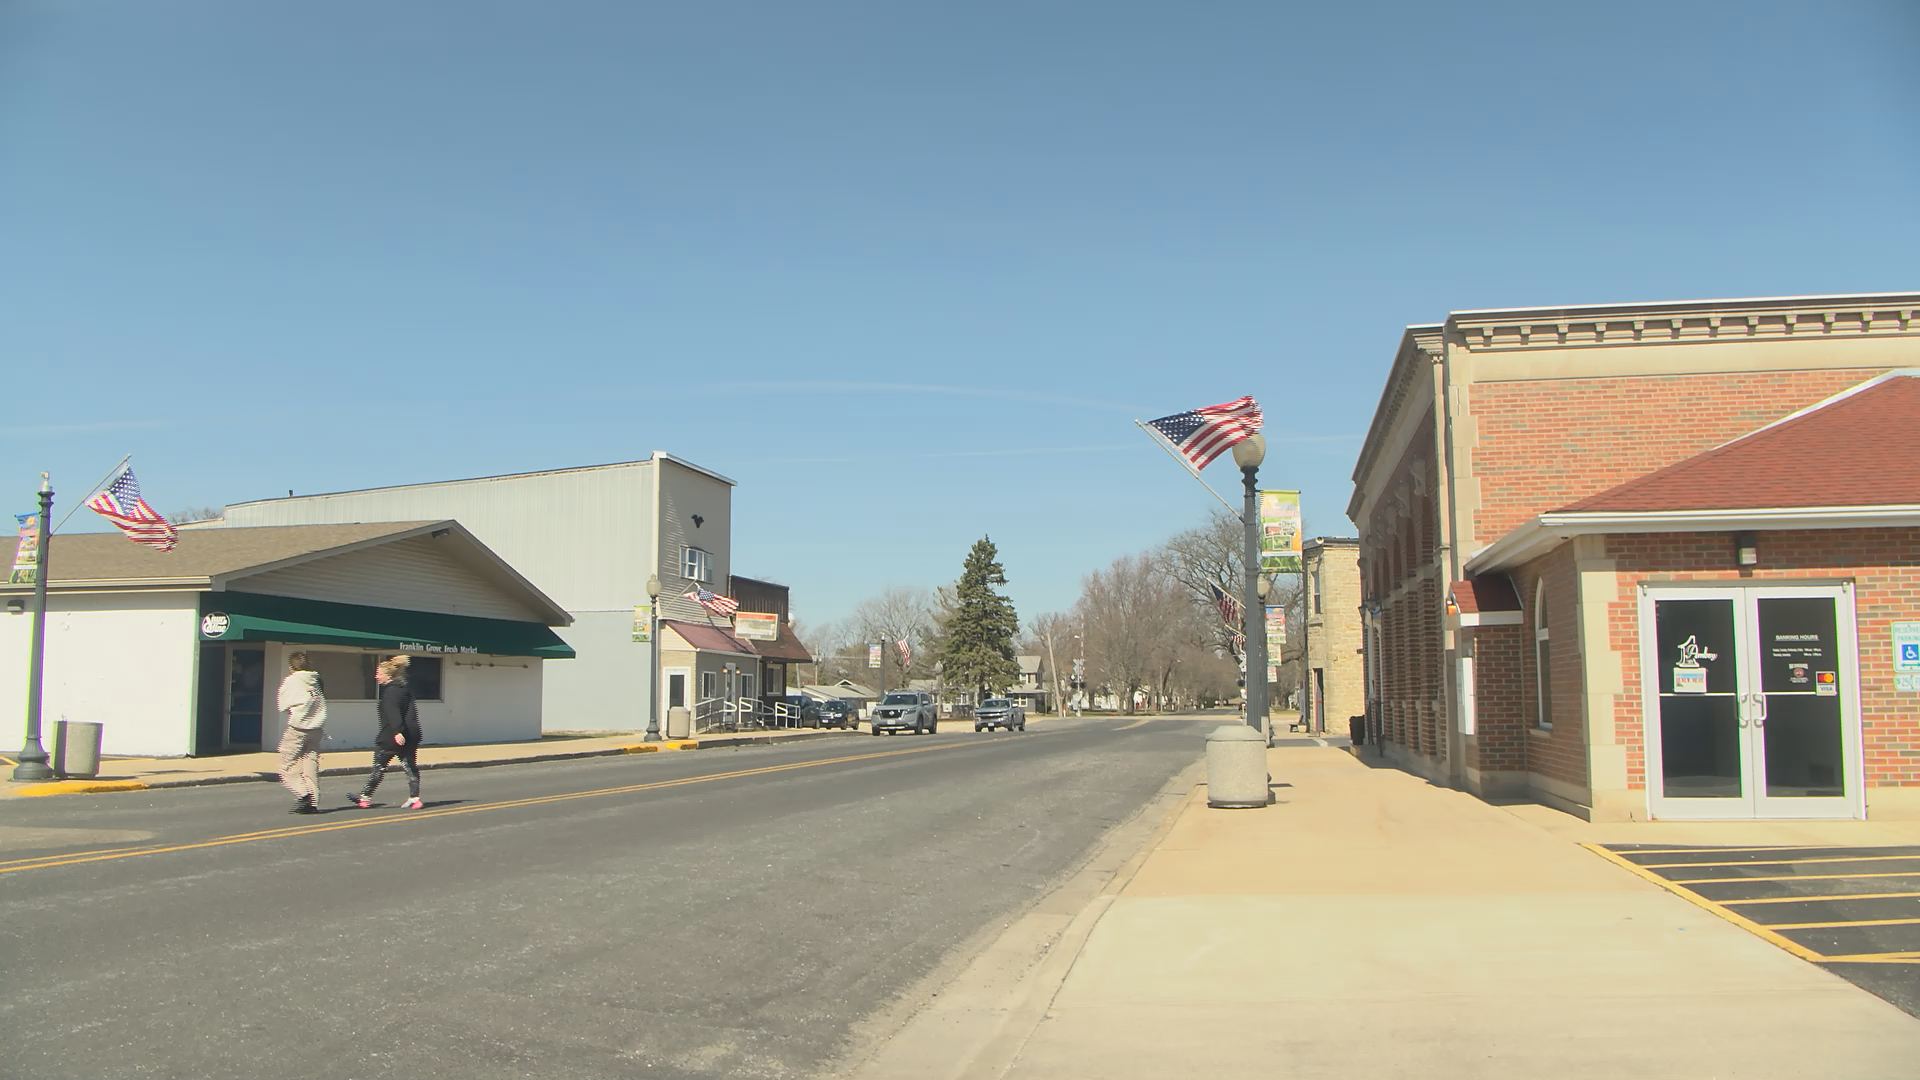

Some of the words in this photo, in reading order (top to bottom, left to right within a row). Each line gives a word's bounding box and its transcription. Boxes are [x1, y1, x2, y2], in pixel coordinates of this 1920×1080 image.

[399, 642, 424, 651] Franklin
[426, 644, 442, 652] Grove
[444, 645, 458, 653] Fresh
[460, 646, 478, 654] Market
[1685, 644, 1718, 661] Amboy
